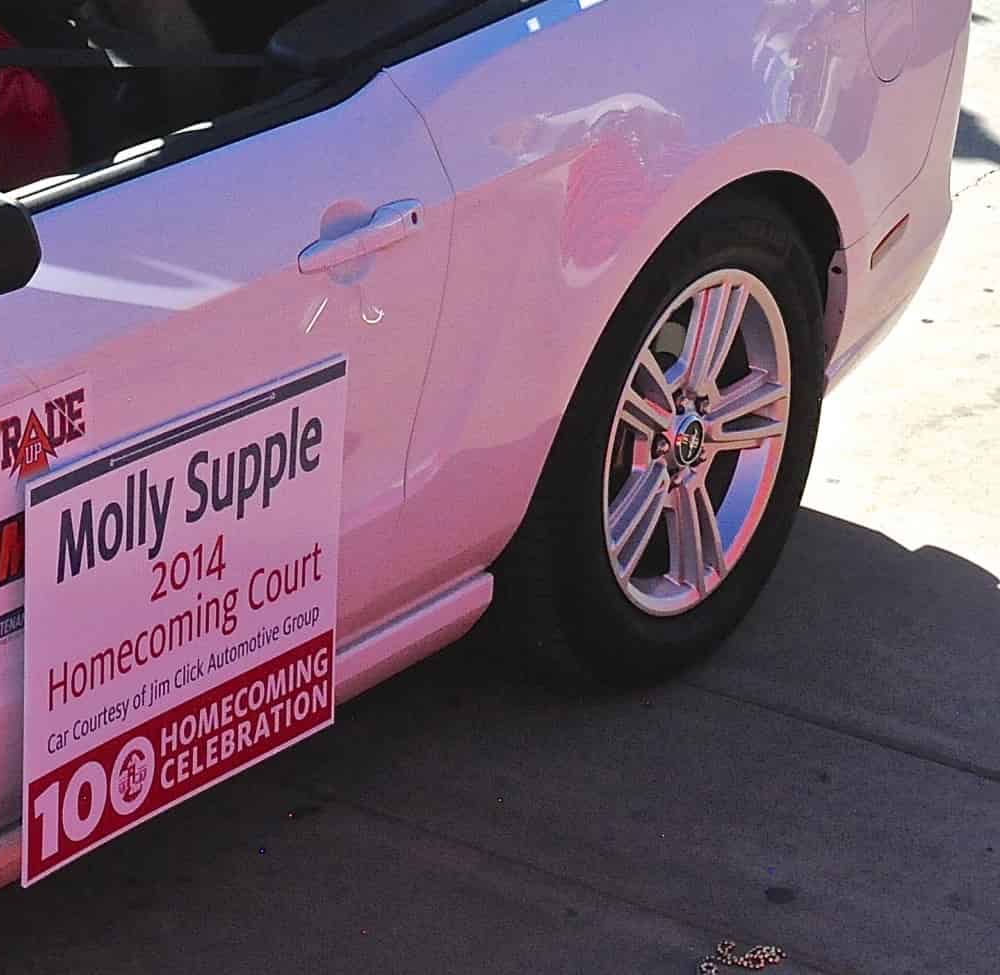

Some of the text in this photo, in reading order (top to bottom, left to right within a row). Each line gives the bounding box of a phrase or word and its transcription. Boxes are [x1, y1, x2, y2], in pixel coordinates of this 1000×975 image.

[25, 442, 42, 465] UP
[56, 406, 323, 585] Molly Supple
[48, 542, 322, 712] Homecoming Court
[150, 534, 226, 602] 2014
[47, 606, 320, 754] Car Courtesy of Jim Click Automotive Group
[160, 647, 329, 757] HOMECOMING
[160, 679, 328, 790] CELEBRATION
[34, 735, 156, 862] 100
